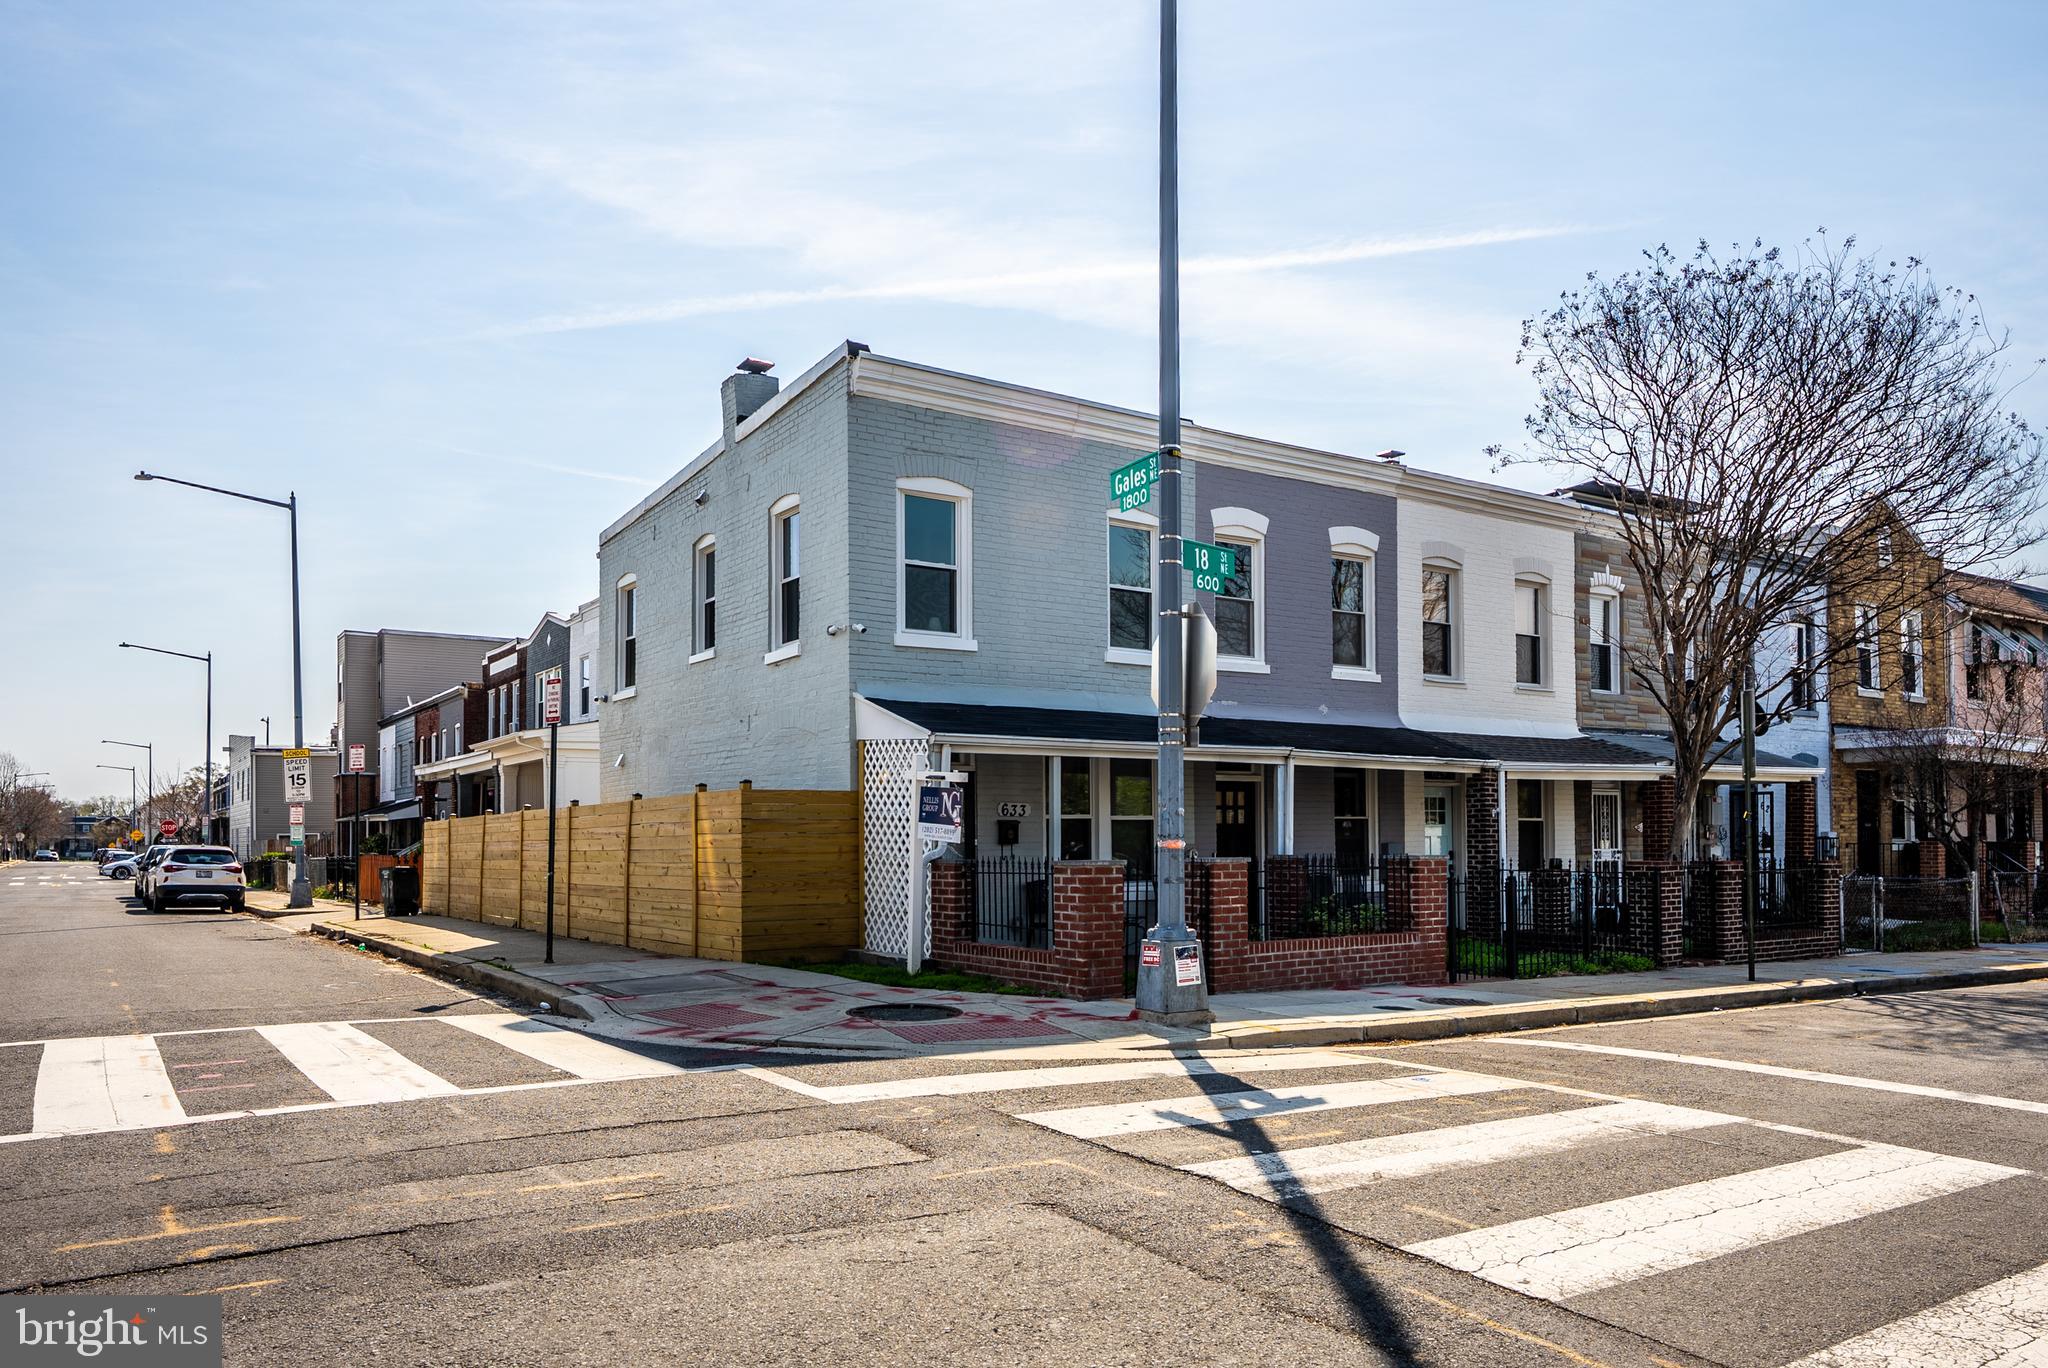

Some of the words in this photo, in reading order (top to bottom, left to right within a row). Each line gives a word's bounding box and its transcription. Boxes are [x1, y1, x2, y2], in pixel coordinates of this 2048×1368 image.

[1114, 468, 1147, 495] Gales
[1149, 457, 1157, 469] St
[1149, 469, 1158, 480] NE
[1122, 488, 1147, 510] 1800
[1194, 547, 1209, 570] 18
[1220, 551, 1228, 563] St
[1220, 563, 1229, 575] NE
[1196, 574, 1219, 592] 600
[288, 773, 306, 786] 15
[923, 796, 939, 804] NELLIS
[922, 804, 938, 812] GROUP
[1001, 803, 1026, 816] 633
